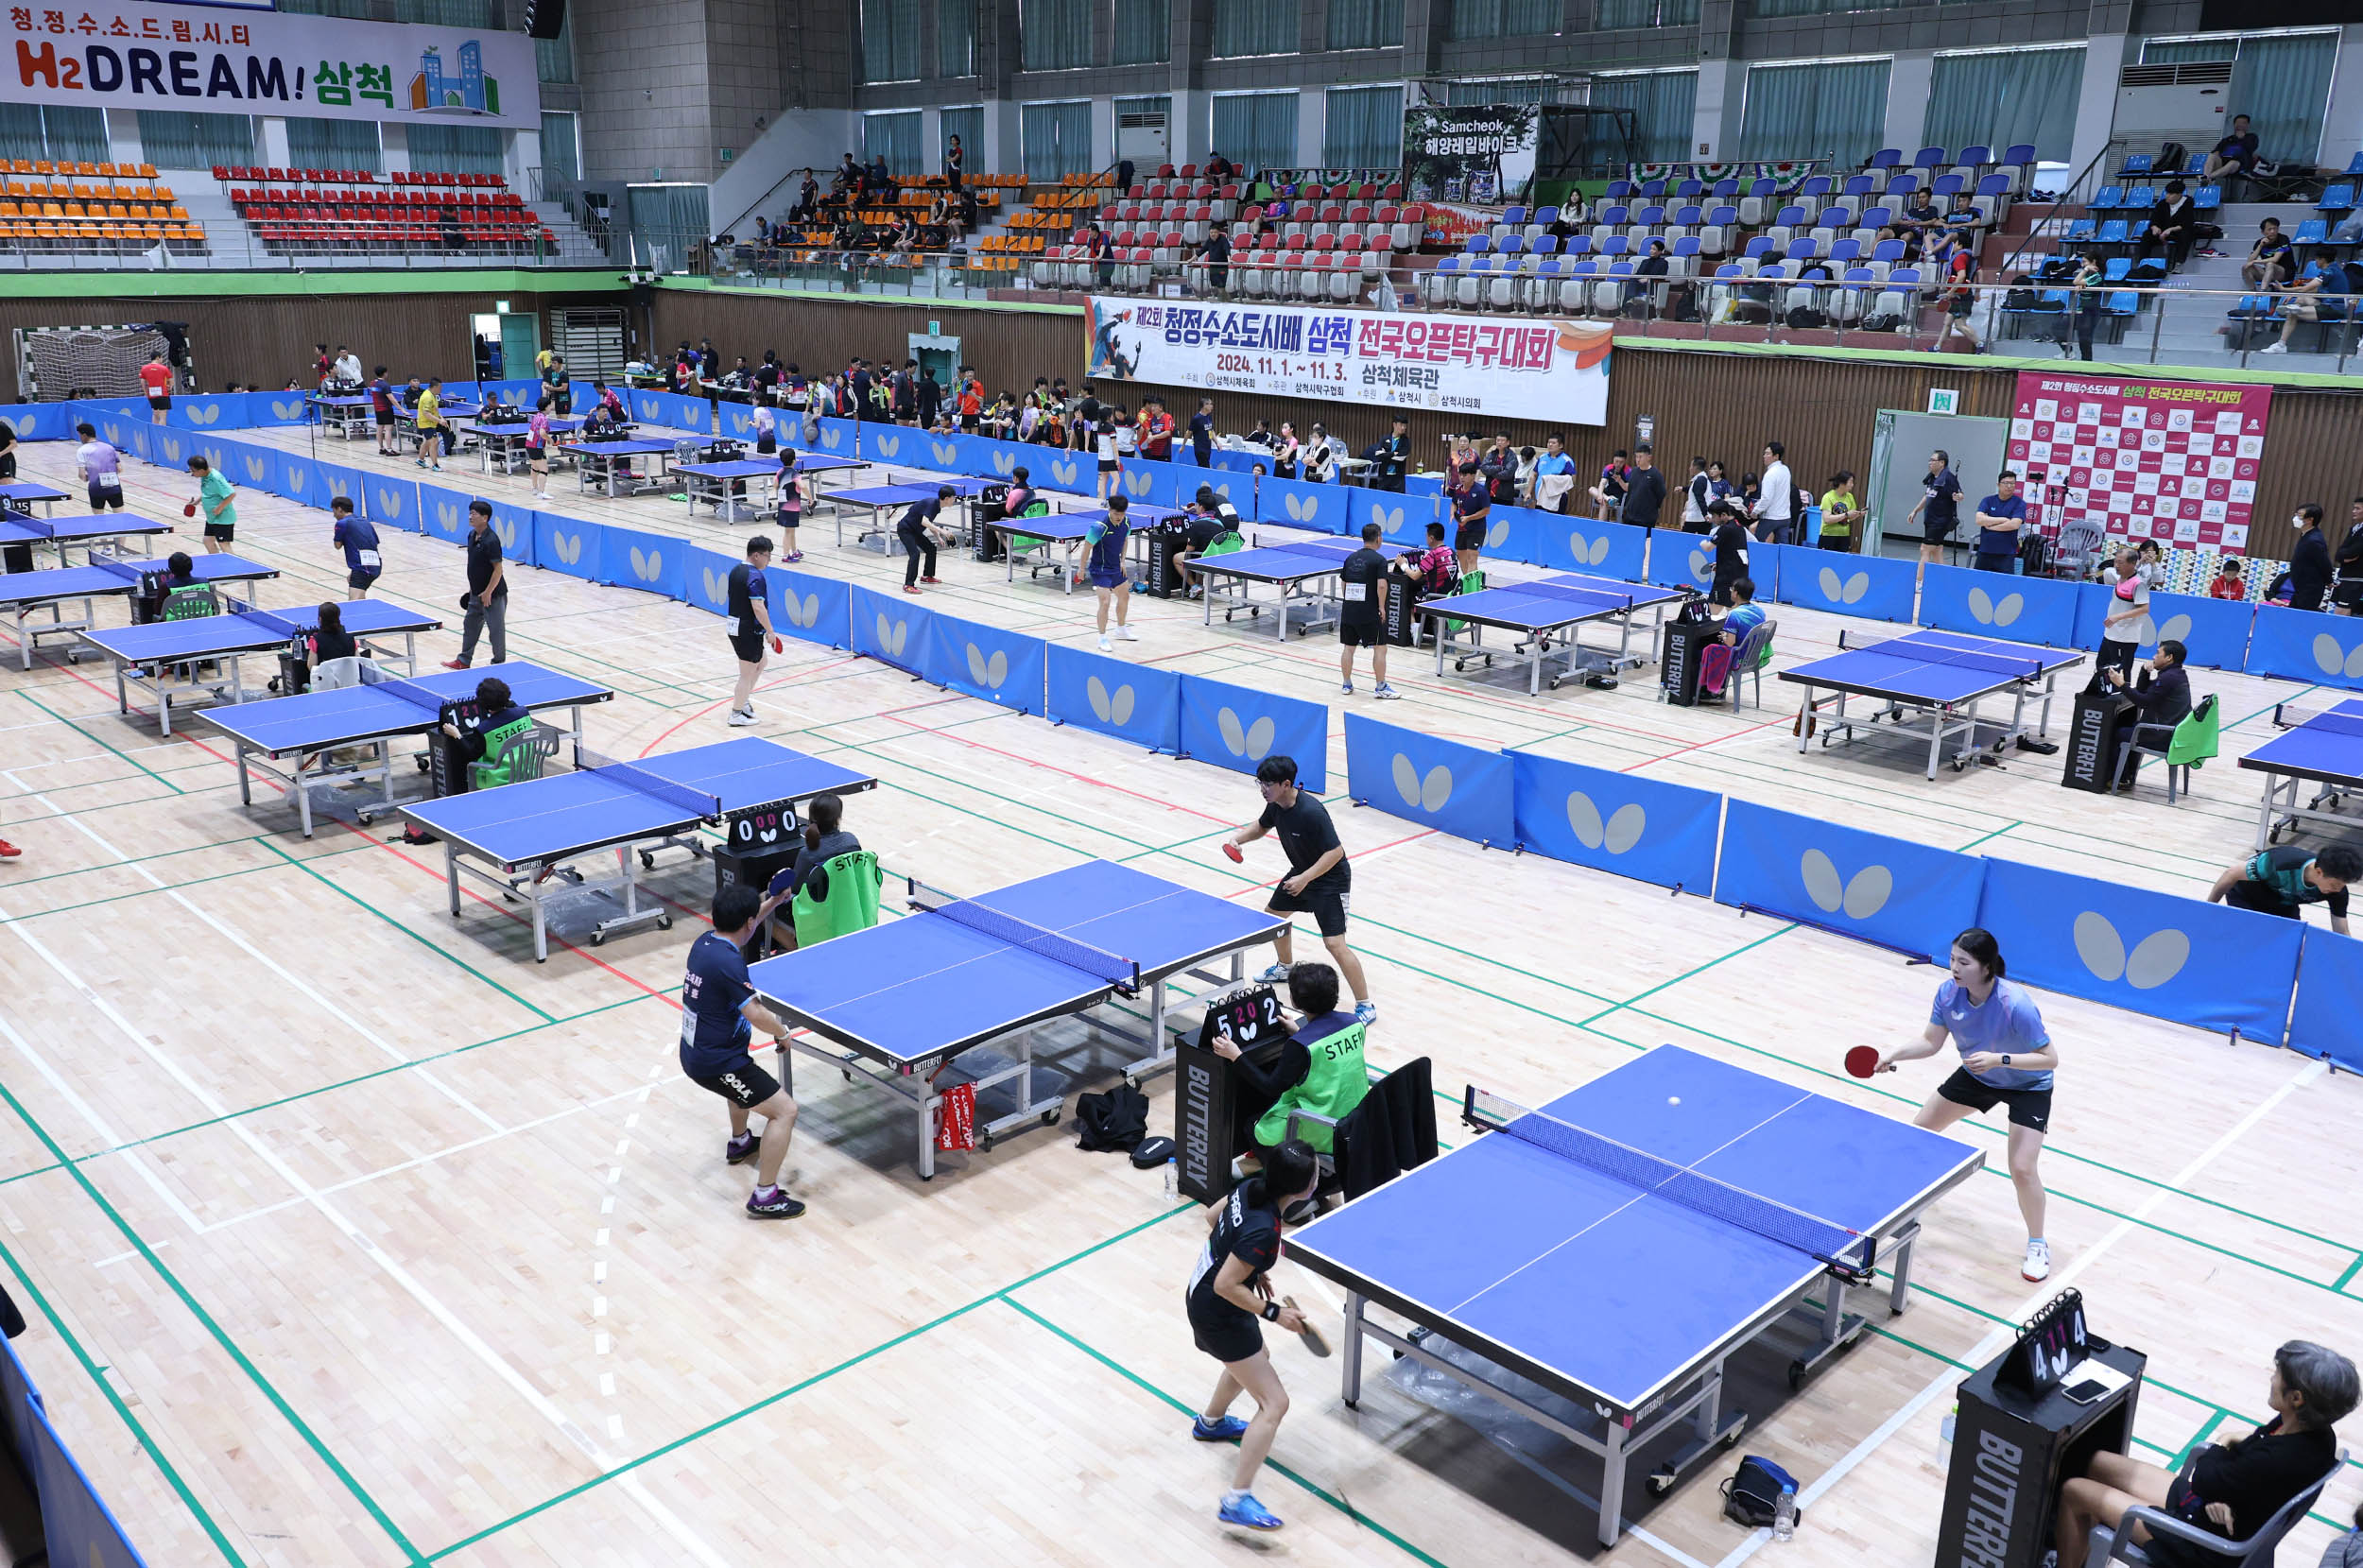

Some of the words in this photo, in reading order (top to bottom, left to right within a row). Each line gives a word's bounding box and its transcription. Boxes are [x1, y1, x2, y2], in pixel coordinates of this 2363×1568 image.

[10, 7, 250, 46] 청.정.수.소.드.림.시.티
[15, 40, 304, 100] H2DREAM!
[313, 60, 394, 109] 삼척
[1441, 119, 1504, 133] Samcheok
[1425, 136, 1518, 155] 해양레일바이크
[1136, 305, 1163, 328] 제2회
[1164, 307, 1303, 352] 청정수소도시배
[1307, 316, 1354, 356] 삼척
[1358, 319, 1556, 370] 전국오픈탁구대회
[1216, 353, 1254, 373] 2024.
[1361, 363, 1440, 390] 삼척체육관
[1185, 372, 1199, 384] 주최
[1216, 374, 1256, 388] 삼척시체육회
[1272, 380, 1287, 391] 주관
[1295, 382, 1345, 397] 삼척시탁구협회
[2041, 380, 2062, 391] 제2회
[2122, 386, 2146, 399] 삼척
[2147, 387, 2243, 405] 전국오픈탁구대회
[1362, 388, 1377, 400] 후원
[1398, 392, 1423, 405] 삼척시
[1440, 395, 1481, 409] 삼척시의회
[975, 510, 983, 556] BUTTERFLY
[1166, 521, 1173, 532] 5
[1184, 518, 1190, 529] 6
[1152, 542, 1163, 592] BUTTERFLY
[148, 576, 158, 590] 1
[1388, 583, 1401, 639] BUTTERFLY
[1689, 607, 1695, 620] 1
[1703, 603, 1710, 616] 2
[1667, 634, 1685, 698] BUTTERFLY
[448, 709, 459, 727] 1
[2075, 709, 2103, 783] BUTTERFLY
[434, 746, 447, 798] BUTTE
[738, 819, 753, 841] 0
[756, 815, 765, 829] 0
[768, 813, 776, 826] 0
[782, 810, 796, 832] 0
[515, 859, 543, 872] BUTTERFLY
[1217, 1014, 1233, 1041] 5
[1235, 1006, 1245, 1024] 2
[1247, 1001, 1256, 1019] 0
[1263, 997, 1278, 1025] 2
[913, 1054, 943, 1073] BUTTERFLY
[724, 1073, 751, 1099] OOLA
[1185, 1064, 1210, 1189] BUTTERFLY
[2035, 1342, 2047, 1381] 4
[2047, 1331, 2056, 1352] 1
[2058, 1321, 2066, 1343] 1
[2074, 1310, 2086, 1347] 4
[1635, 1392, 1665, 1423] BUTTERFLY
[1960, 1429, 2023, 1568] BUTTERF
